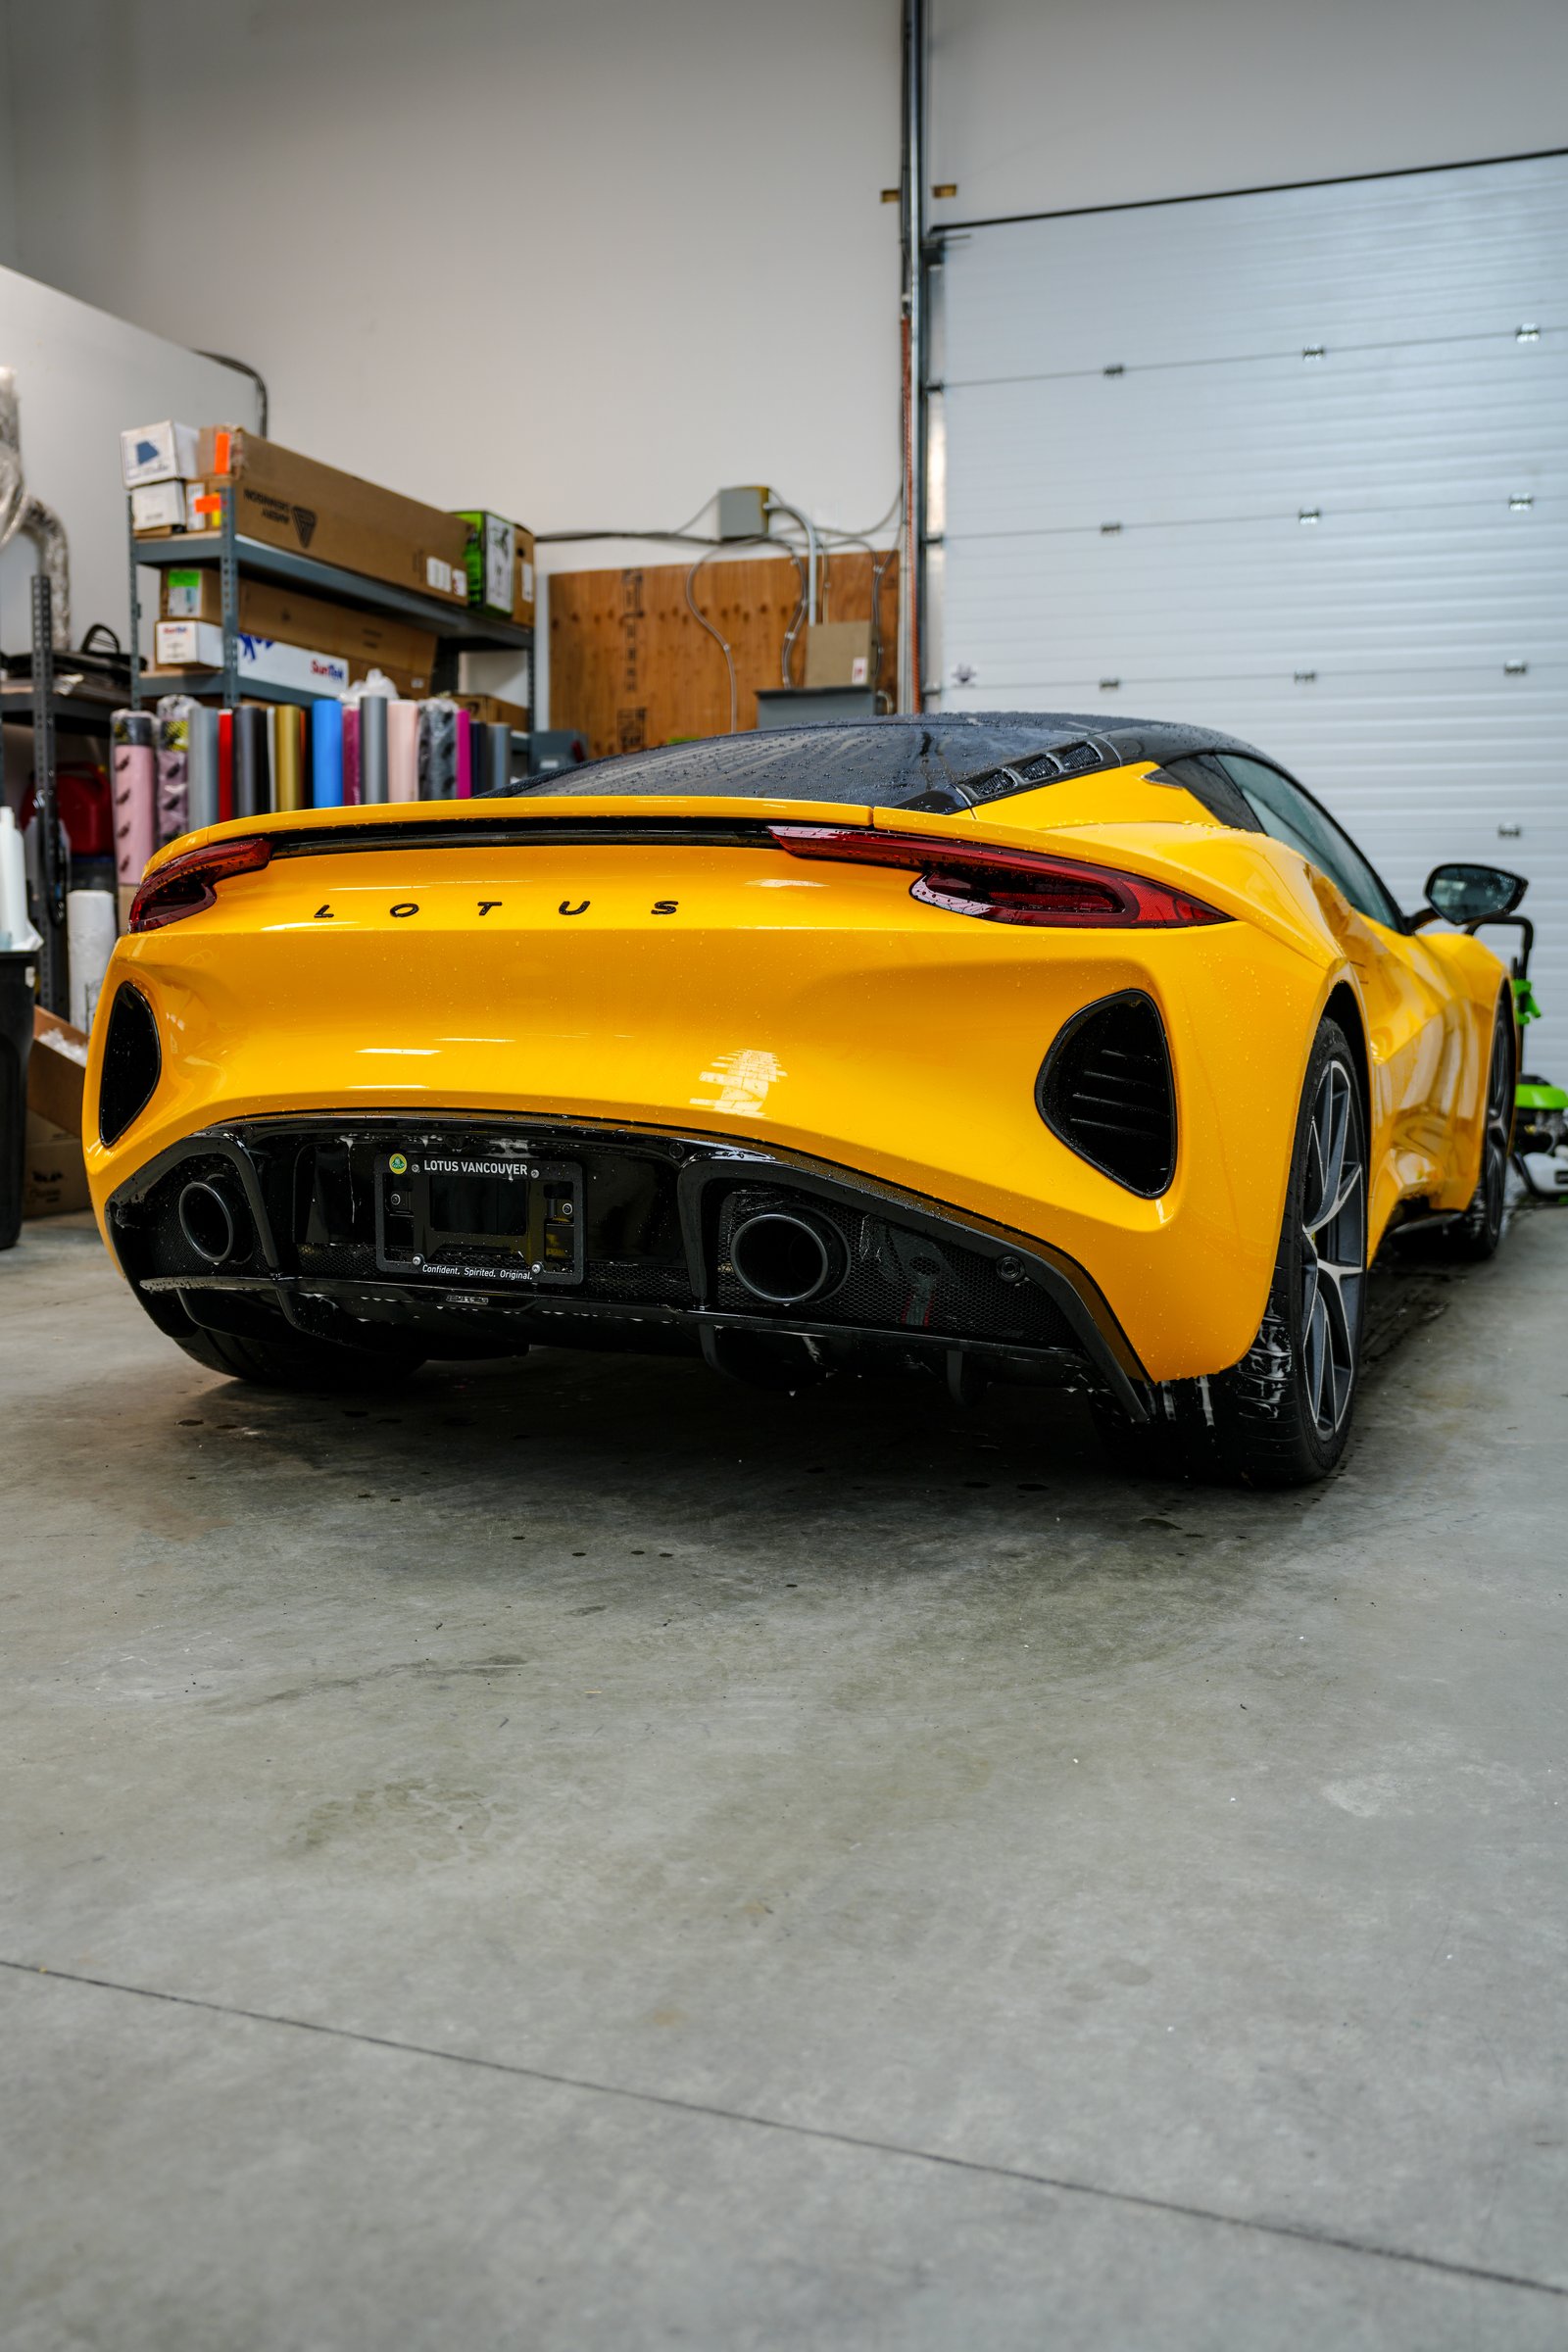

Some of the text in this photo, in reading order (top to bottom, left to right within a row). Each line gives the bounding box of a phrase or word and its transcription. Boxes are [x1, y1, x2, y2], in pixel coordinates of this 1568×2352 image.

[311, 659, 344, 679] SunTek
[314, 900, 679, 918] LOTUS
[423, 1159, 528, 1175] LOTUS VANCOUVER
[422, 1264, 533, 1280] Confident. Spirited. Original.
